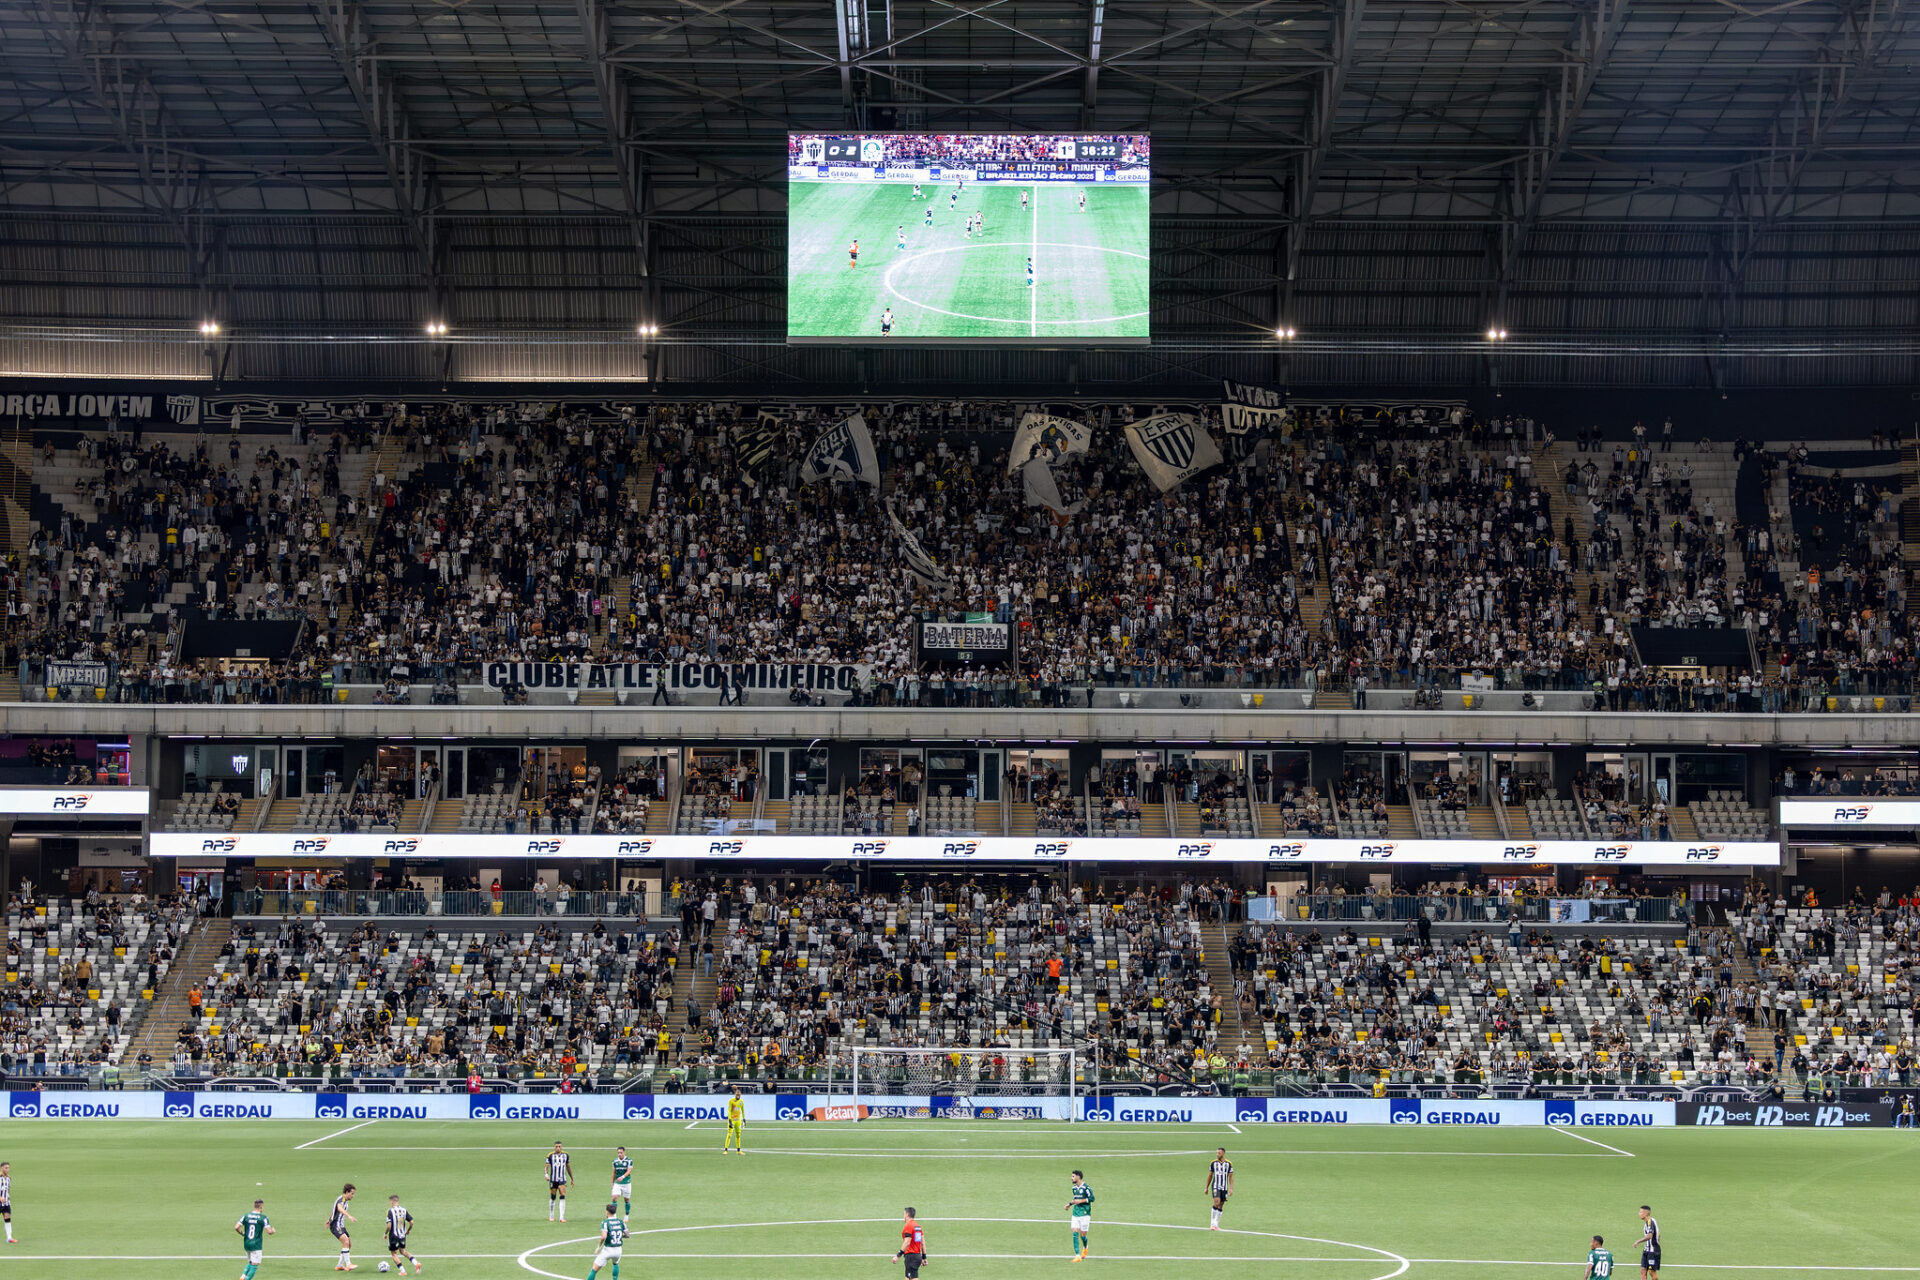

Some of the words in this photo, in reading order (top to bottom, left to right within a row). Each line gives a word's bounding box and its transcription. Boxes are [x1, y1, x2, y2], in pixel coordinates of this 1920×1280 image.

[1081, 145, 1116, 156] 36:22
[1224, 380, 1279, 406] LUTAR
[0, 395, 61, 420] RÇA
[66, 395, 152, 418] JOVEM
[1027, 419, 1045, 430] DAS
[1048, 417, 1082, 441] ANTIGAS
[1145, 416, 1181, 438] CAM
[926, 626, 1006, 648] BATERIA
[488, 663, 579, 688] CLUBE
[54, 797, 88, 808] APS
[1835, 808, 1869, 819] APS
[203, 840, 236, 851] APS
[294, 840, 327, 851] APS
[385, 841, 418, 851] APS
[528, 842, 561, 852] APS
[619, 842, 652, 852] APS
[710, 843, 743, 853] APS
[853, 844, 886, 854] APS
[944, 844, 977, 854] APS
[1035, 844, 1069, 855] APS
[1179, 845, 1212, 856] APS
[1270, 846, 1303, 856] APS
[1361, 847, 1394, 857] APS
[1504, 848, 1537, 858] APS
[1595, 848, 1628, 858] APS
[1687, 849, 1720, 859] APS
[46, 1104, 119, 1117] GERDAU
[199, 1105, 272, 1118] GERDAU
[353, 1106, 426, 1119] GERDAU
[506, 1107, 579, 1119] GERDAU
[1120, 1109, 1192, 1122] GERDAU
[1273, 1110, 1347, 1123] GERDAU
[1427, 1111, 1500, 1124] GERDAU
[1581, 1113, 1653, 1126] GERDAU
[248, 1224, 256, 1240] 8
[611, 1230, 623, 1245] 32
[1595, 1261, 1609, 1277] 40
